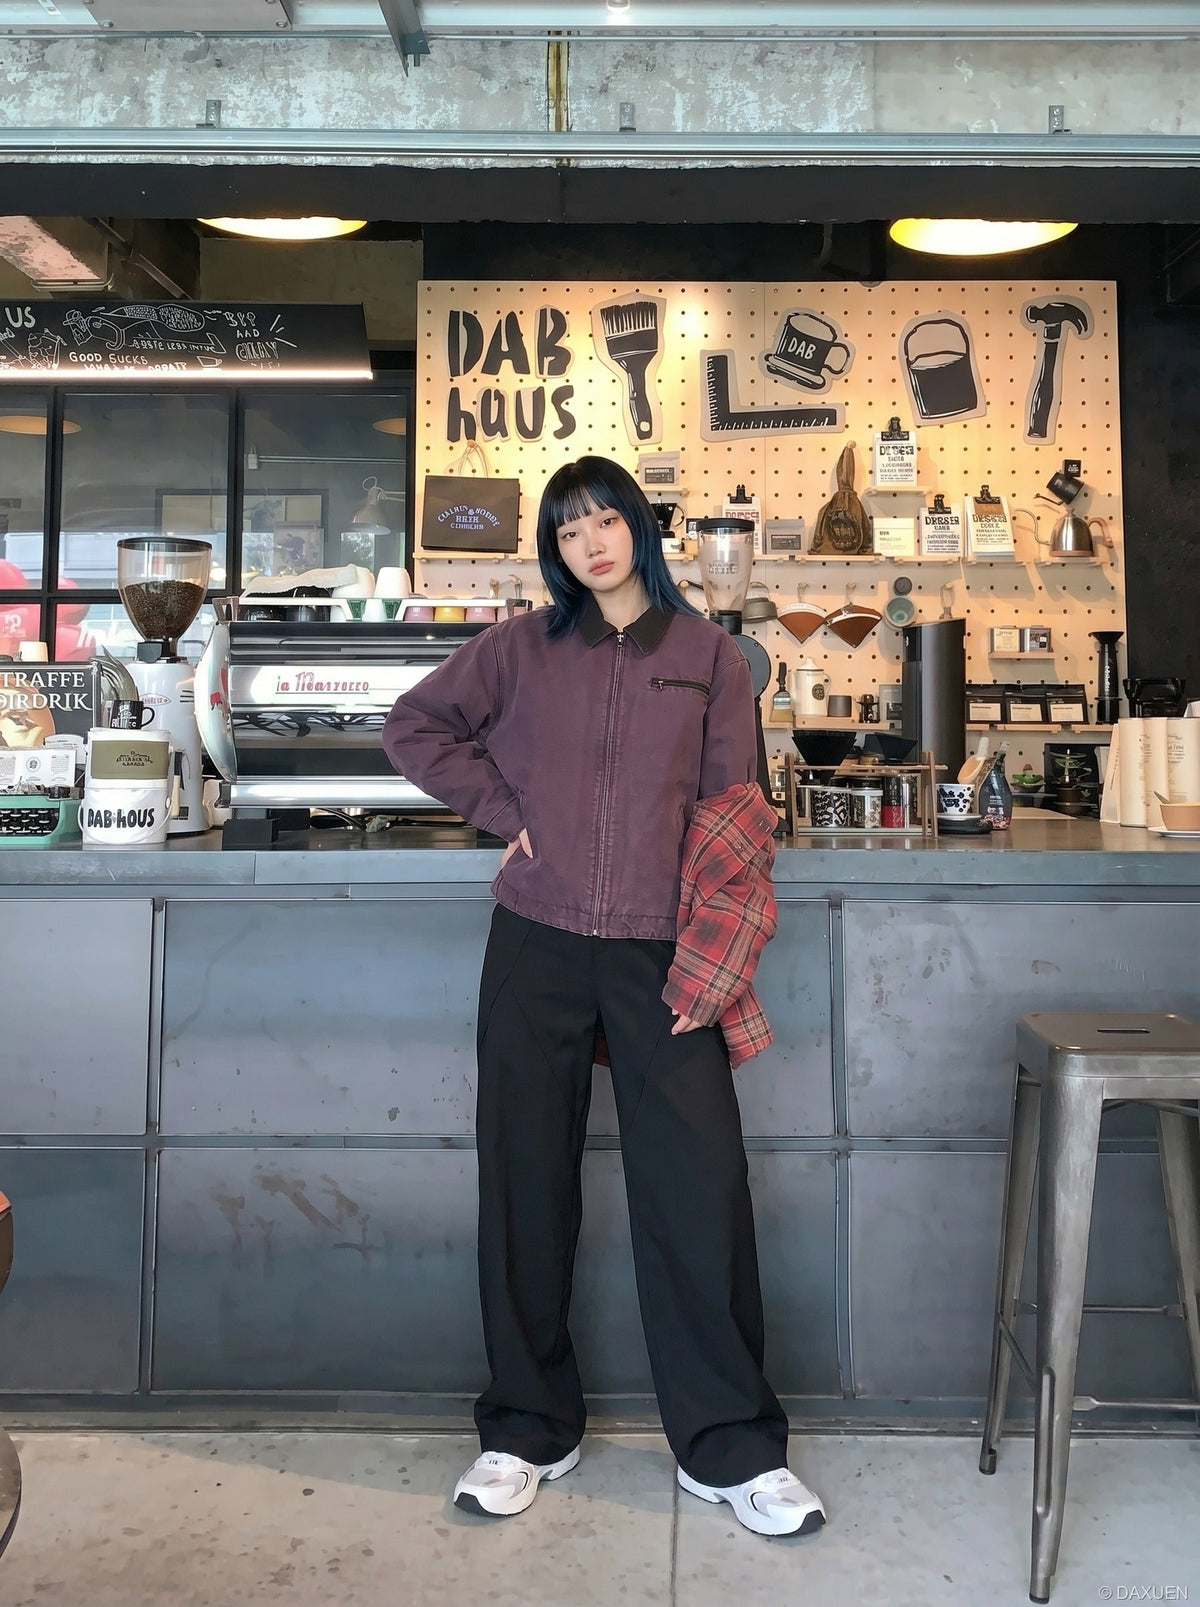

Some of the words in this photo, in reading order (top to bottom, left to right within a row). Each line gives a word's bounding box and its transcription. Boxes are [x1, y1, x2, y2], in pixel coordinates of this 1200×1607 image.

[5, 306, 36, 328] US
[448, 304, 572, 378] DAB
[787, 336, 816, 360] DAB
[69, 351, 102, 362] GOOD
[87, 808, 113, 828] DAB
